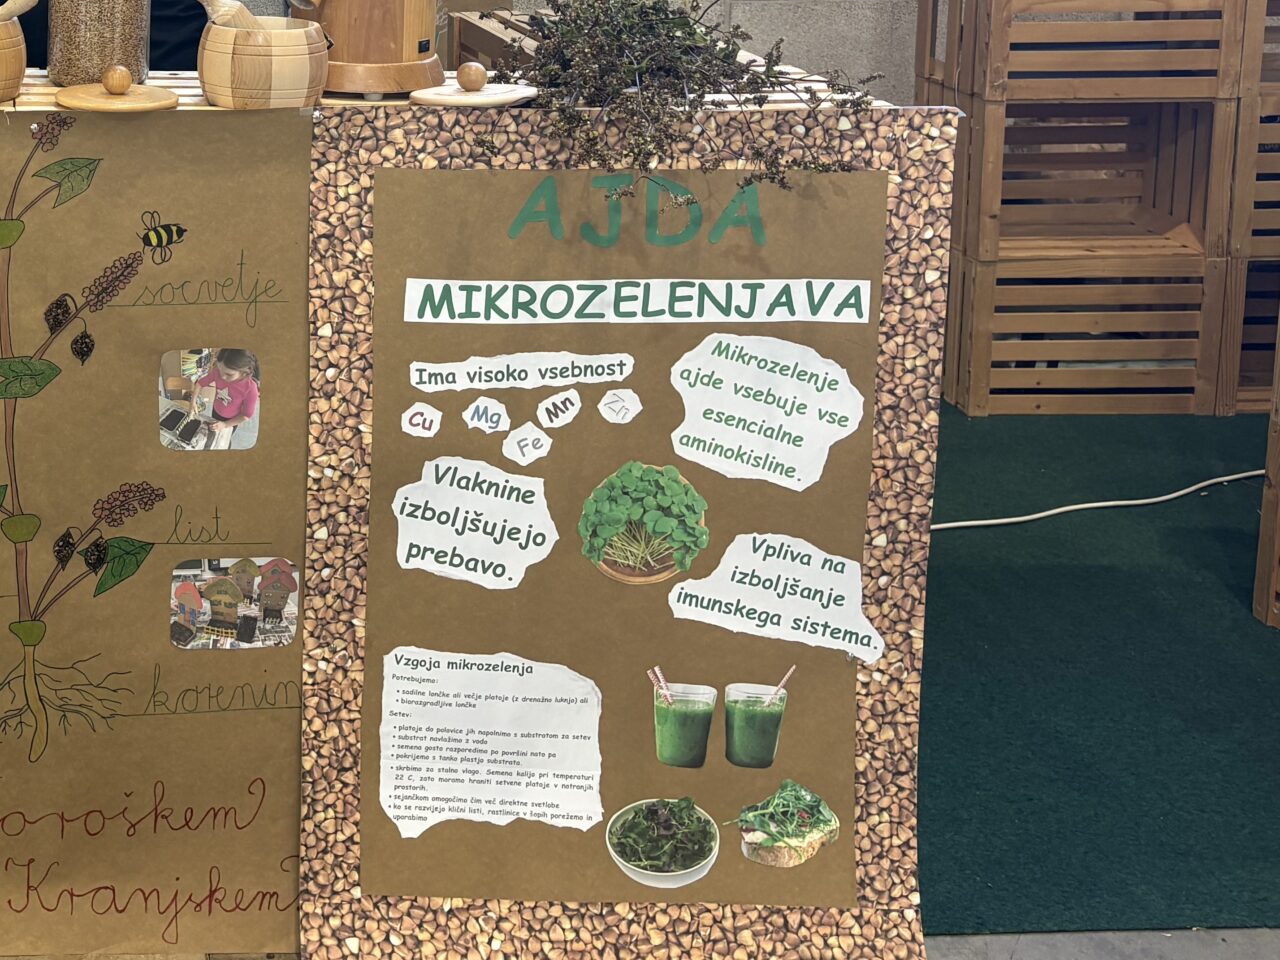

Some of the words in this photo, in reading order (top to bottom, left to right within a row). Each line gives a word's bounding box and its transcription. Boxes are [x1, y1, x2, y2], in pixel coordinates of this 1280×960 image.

[507, 173, 766, 248] AJDA
[131, 248, 283, 329] socvetje
[417, 280, 864, 321] MIKROZELENJAVA
[415, 368, 457, 385] Ima
[466, 364, 528, 383] visoko
[537, 359, 627, 380] vsebnost
[711, 340, 839, 393] Mikrozelenje
[408, 411, 434, 432] Cu
[470, 404, 502, 430] Mg
[544, 396, 575, 424] Mn
[604, 393, 629, 420] Zn
[680, 367, 724, 390] ajde
[733, 383, 808, 416] vsebuje
[817, 408, 849, 428] vse
[516, 435, 544, 457] Fe
[702, 407, 804, 447] esencialne
[679, 433, 802, 482] aminokisline.
[434, 464, 536, 504] Vlaknine
[166, 504, 230, 544] list
[399, 497, 546, 550] izboljšujejo
[405, 542, 513, 581] prebavo.
[751, 536, 812, 566] Vpliva
[821, 557, 846, 574] na
[730, 566, 846, 609] izboljšanje
[676, 587, 782, 628] imunskega
[790, 616, 878, 650] sistema.
[392, 674, 438, 684] Potrebujemo:
[395, 653, 440, 671] Vzgoja
[447, 659, 533, 677] mikrozelenja
[5, 855, 301, 945] Kranjskem
